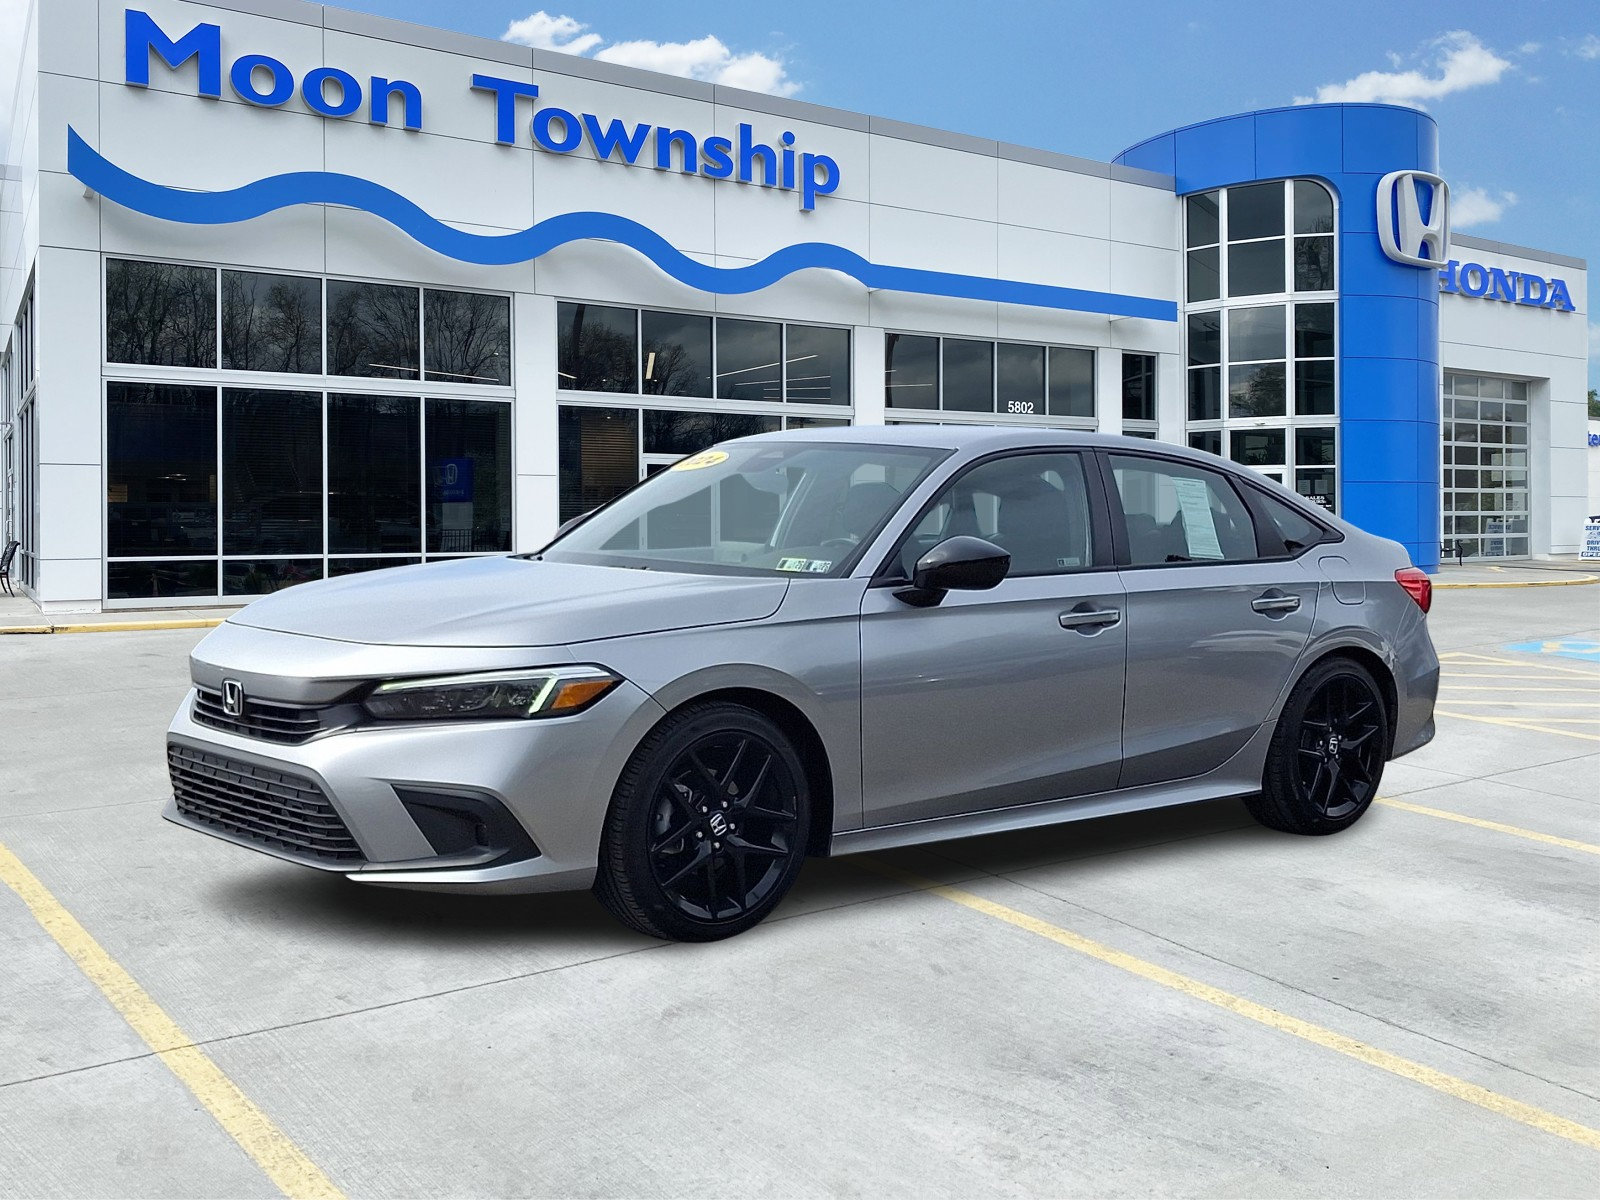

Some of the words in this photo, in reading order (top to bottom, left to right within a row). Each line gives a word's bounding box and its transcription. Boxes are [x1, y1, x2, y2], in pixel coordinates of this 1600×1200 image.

[125, 9, 422, 131] Moon
[470, 73, 841, 211] Township
[1439, 260, 1576, 312] HONDA
[1007, 400, 1034, 414] 5802
